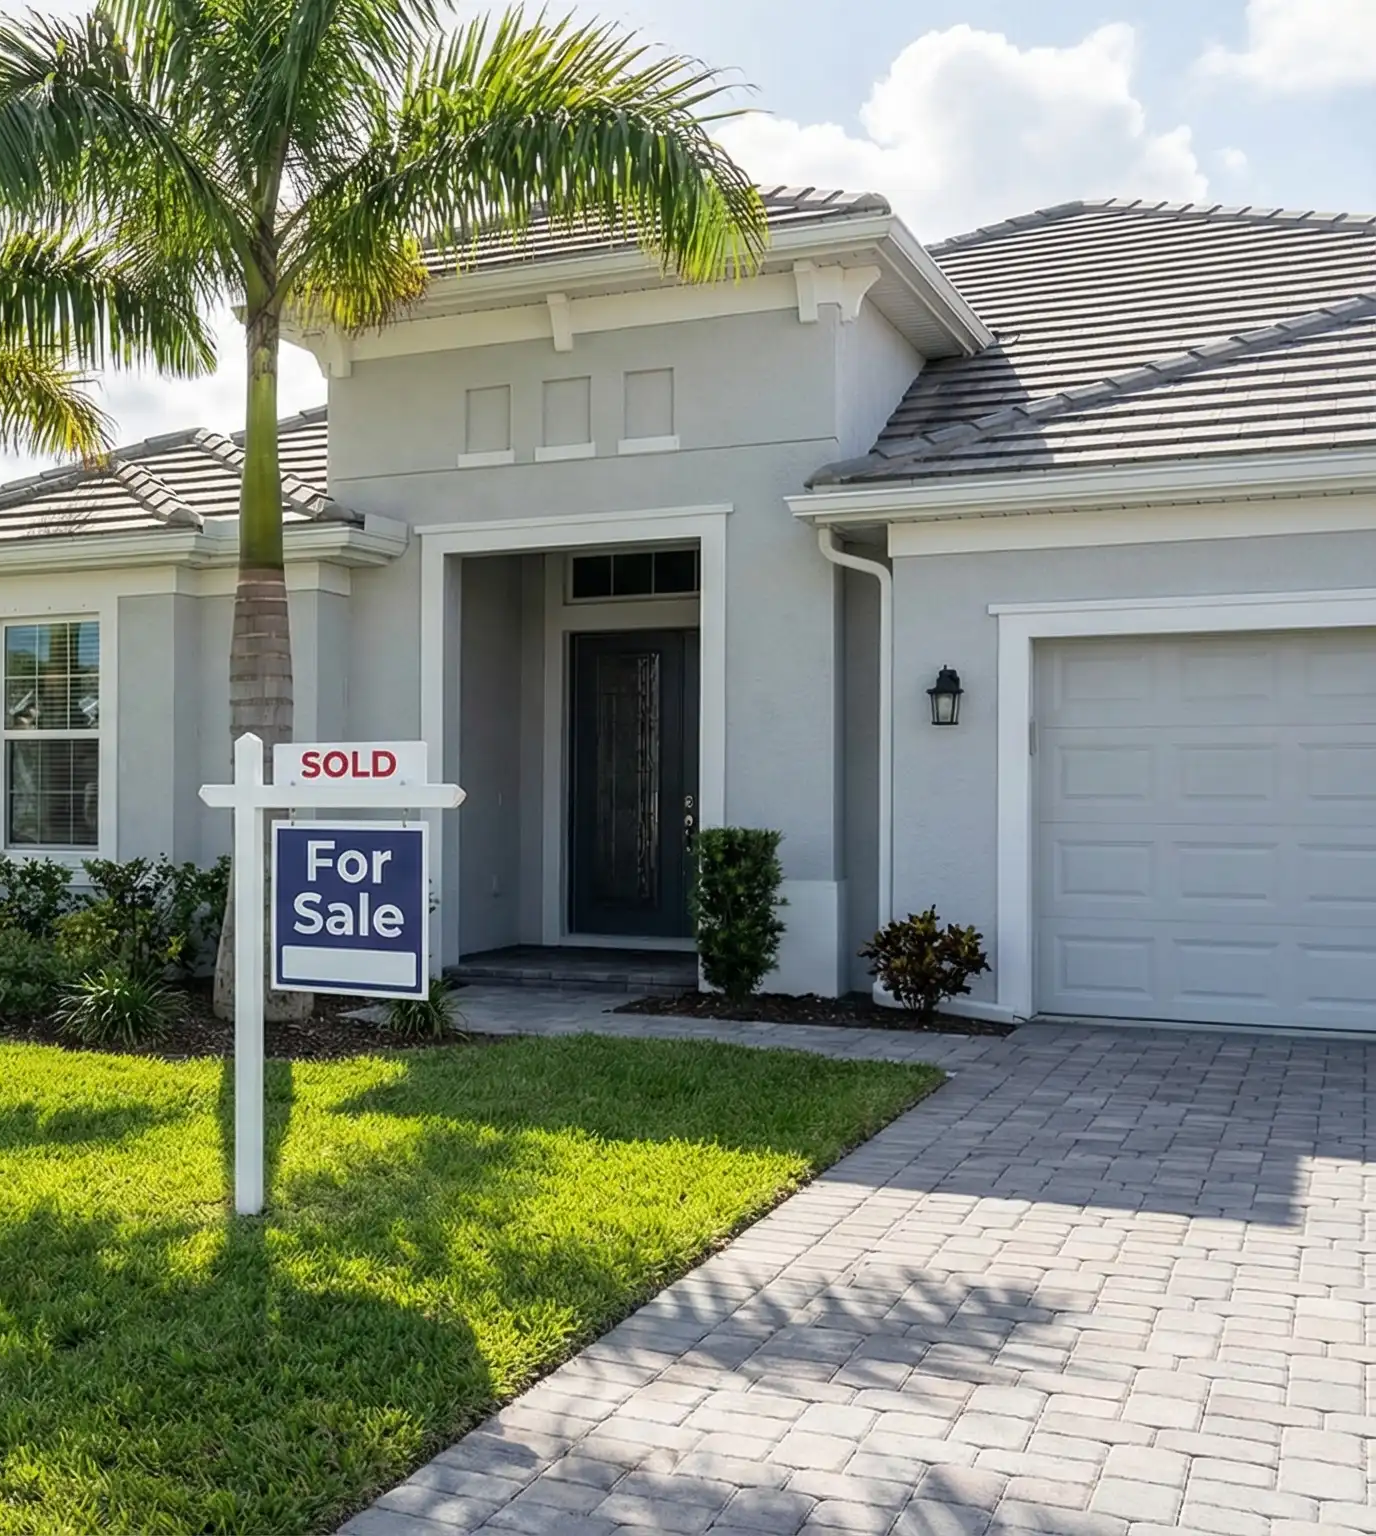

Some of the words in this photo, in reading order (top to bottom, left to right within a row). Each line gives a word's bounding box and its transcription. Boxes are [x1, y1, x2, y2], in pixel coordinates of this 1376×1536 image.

[301, 750, 397, 778] SOLD
[307, 840, 392, 884] For
[293, 892, 405, 938] Sale
